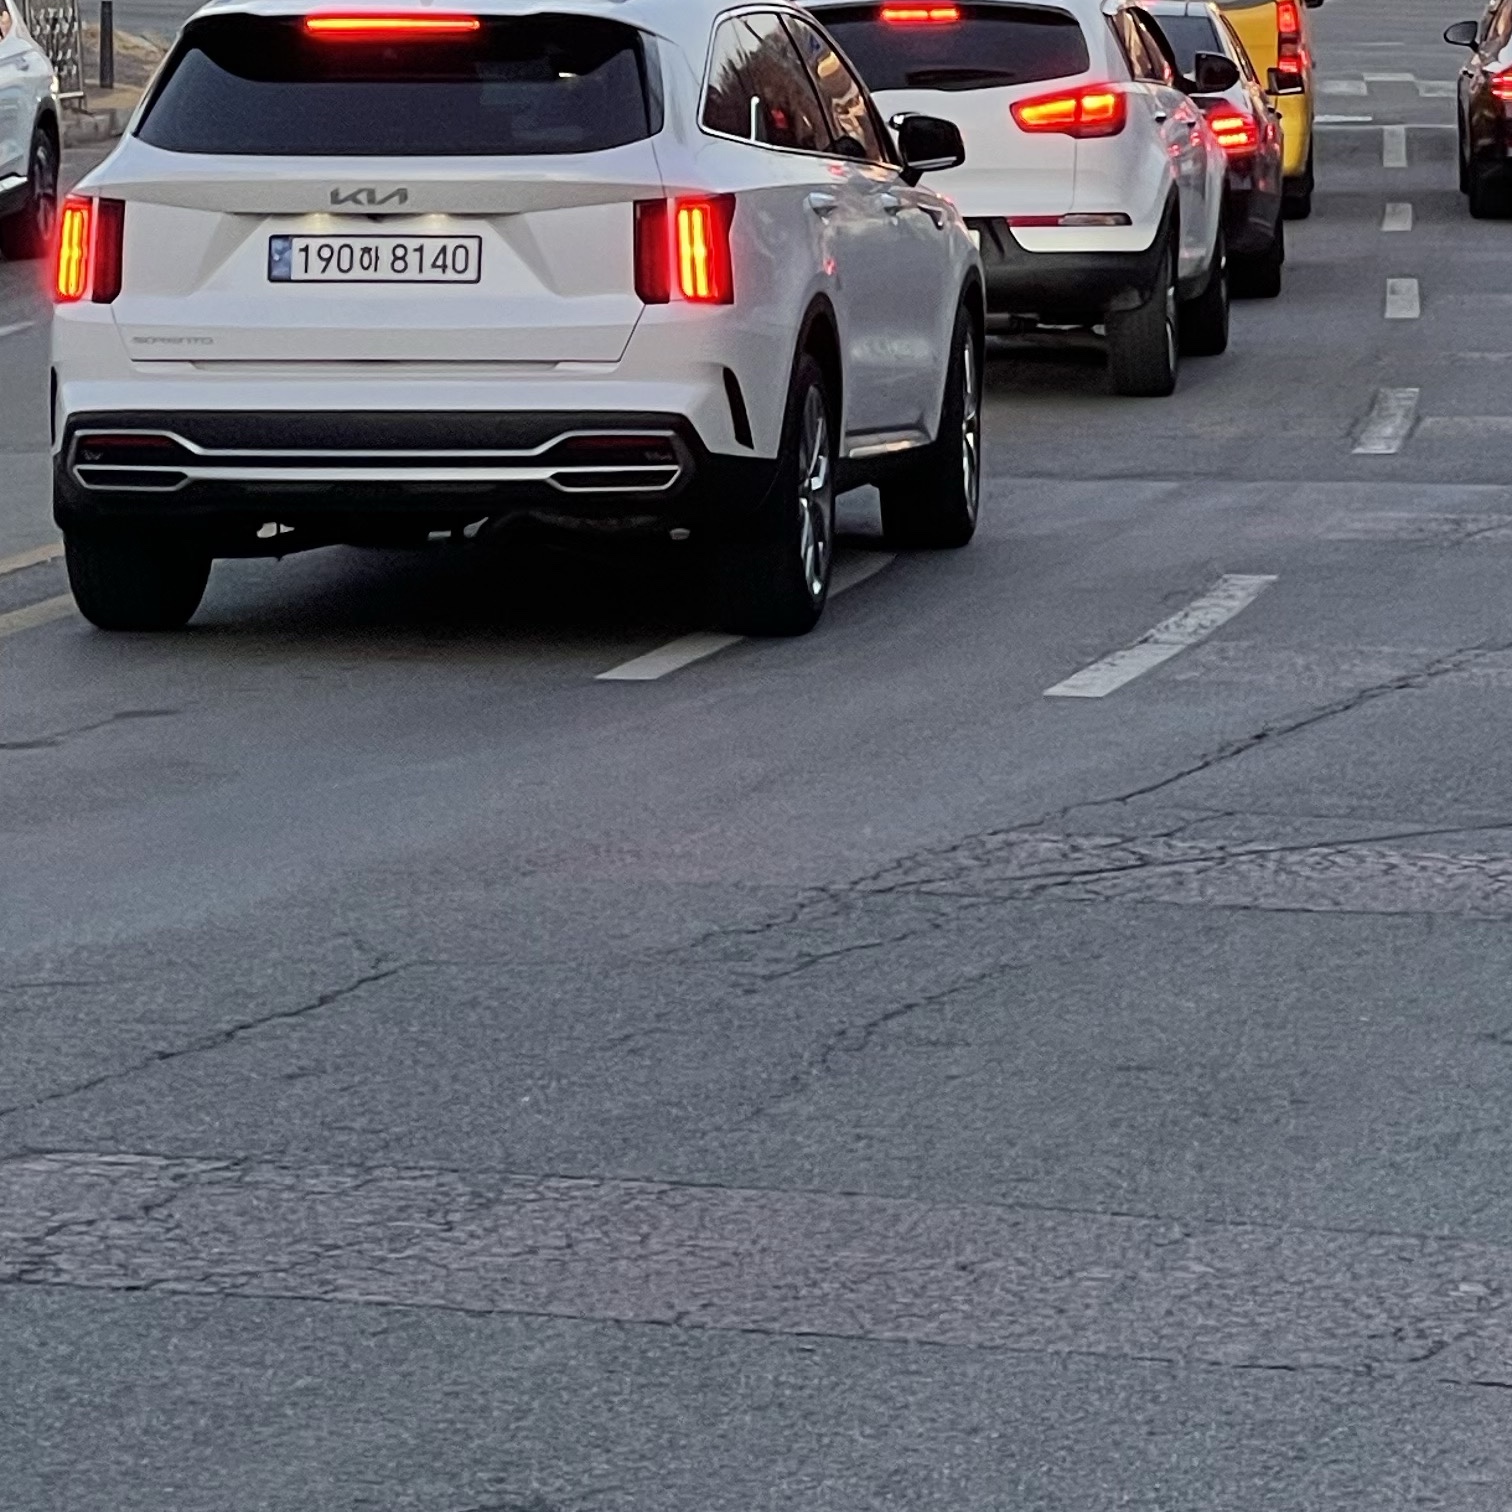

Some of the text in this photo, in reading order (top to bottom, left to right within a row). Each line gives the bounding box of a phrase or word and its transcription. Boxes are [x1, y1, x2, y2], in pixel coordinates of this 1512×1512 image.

[330, 186, 409, 206] KIA
[298, 243, 470, 275] 190하 8140
